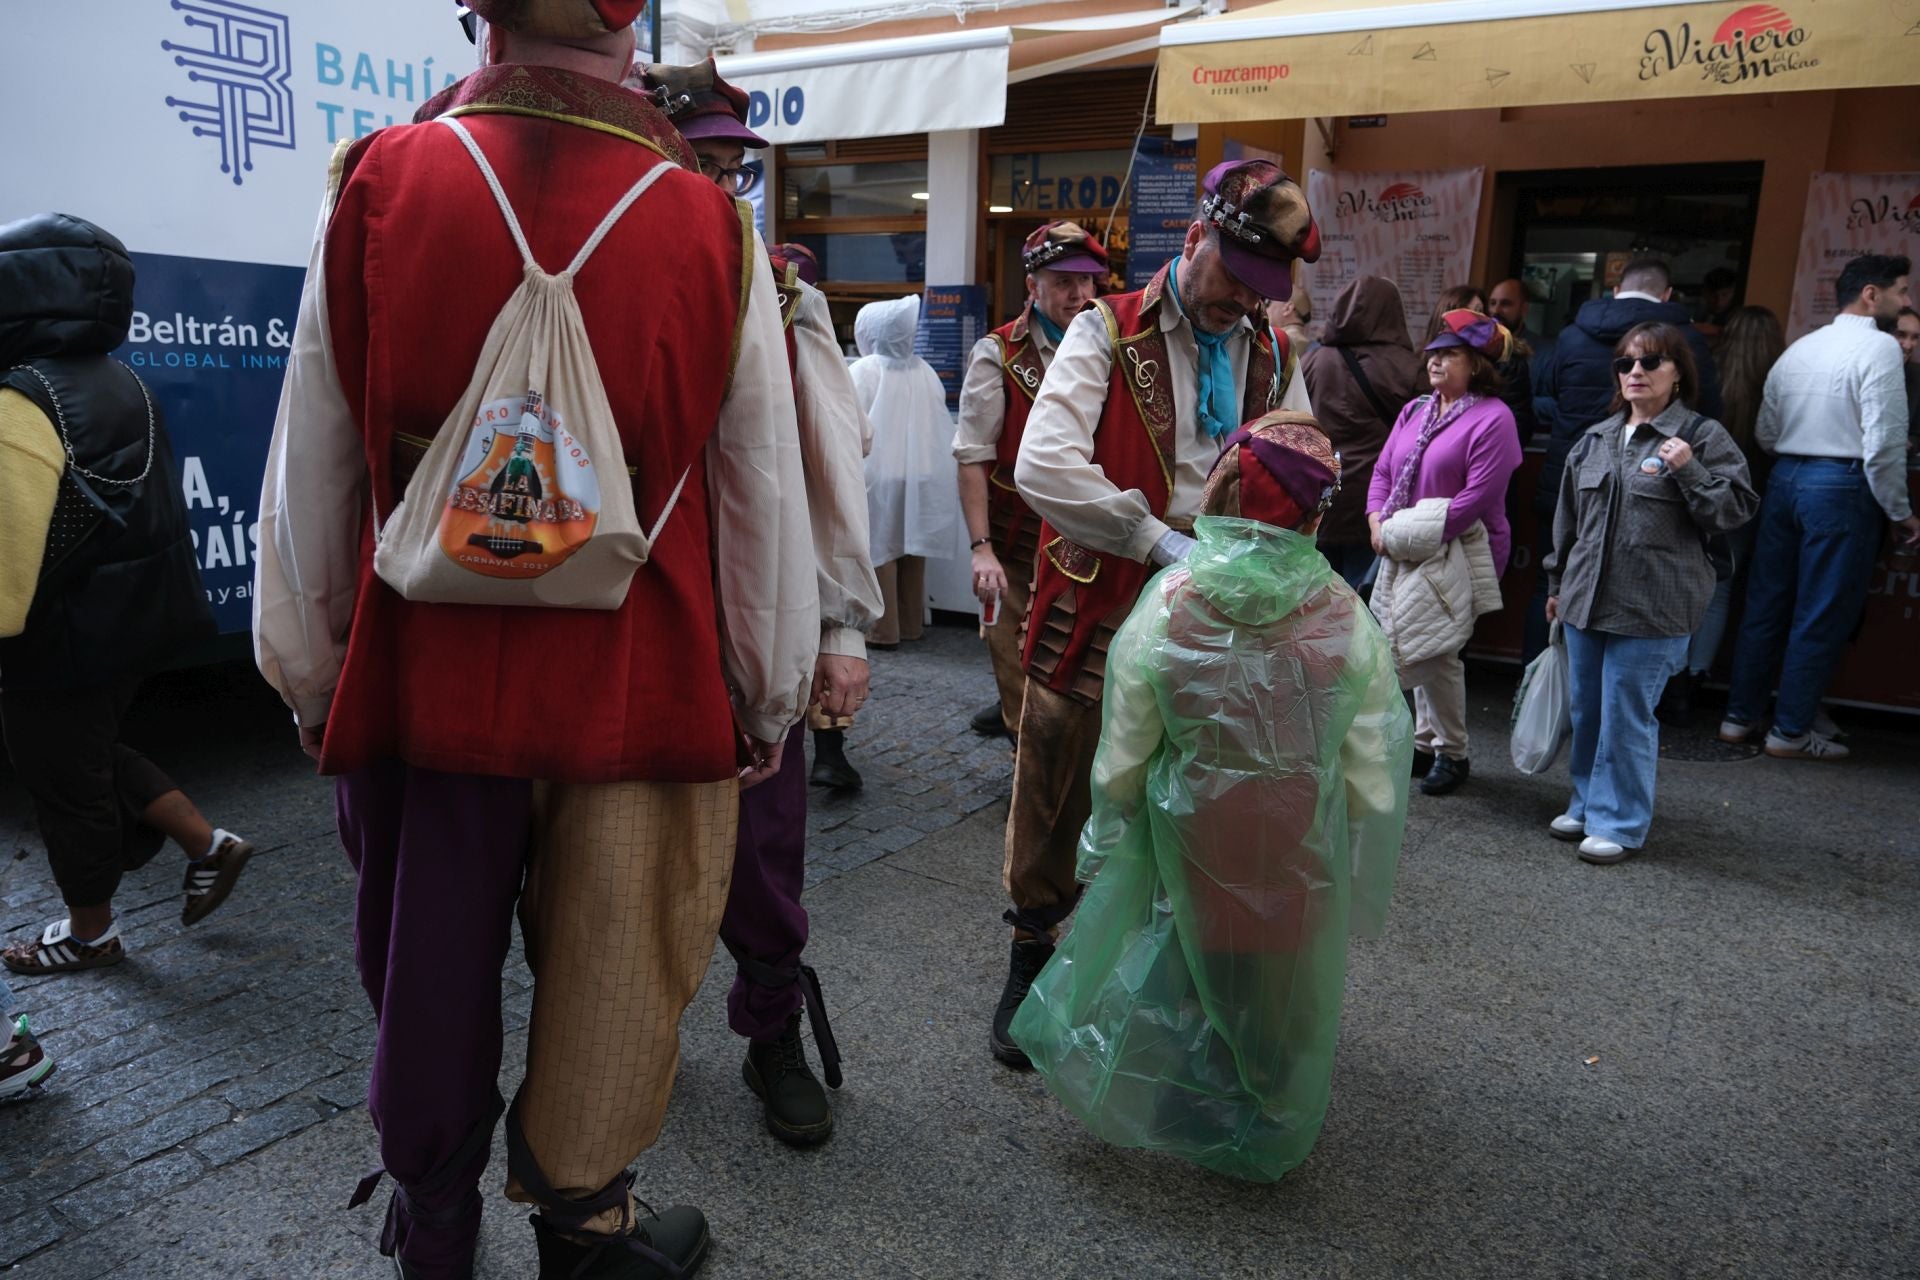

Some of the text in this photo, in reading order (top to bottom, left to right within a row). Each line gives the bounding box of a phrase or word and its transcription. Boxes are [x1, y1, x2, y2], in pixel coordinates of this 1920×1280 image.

[1644, 22, 1812, 70] Viajero
[1192, 64, 1290, 84] Cruzcampo
[128, 311, 292, 348] Beltrán &
[131, 352, 230, 368] GLOBAL
[459, 554, 513, 568] CARNAVAL
